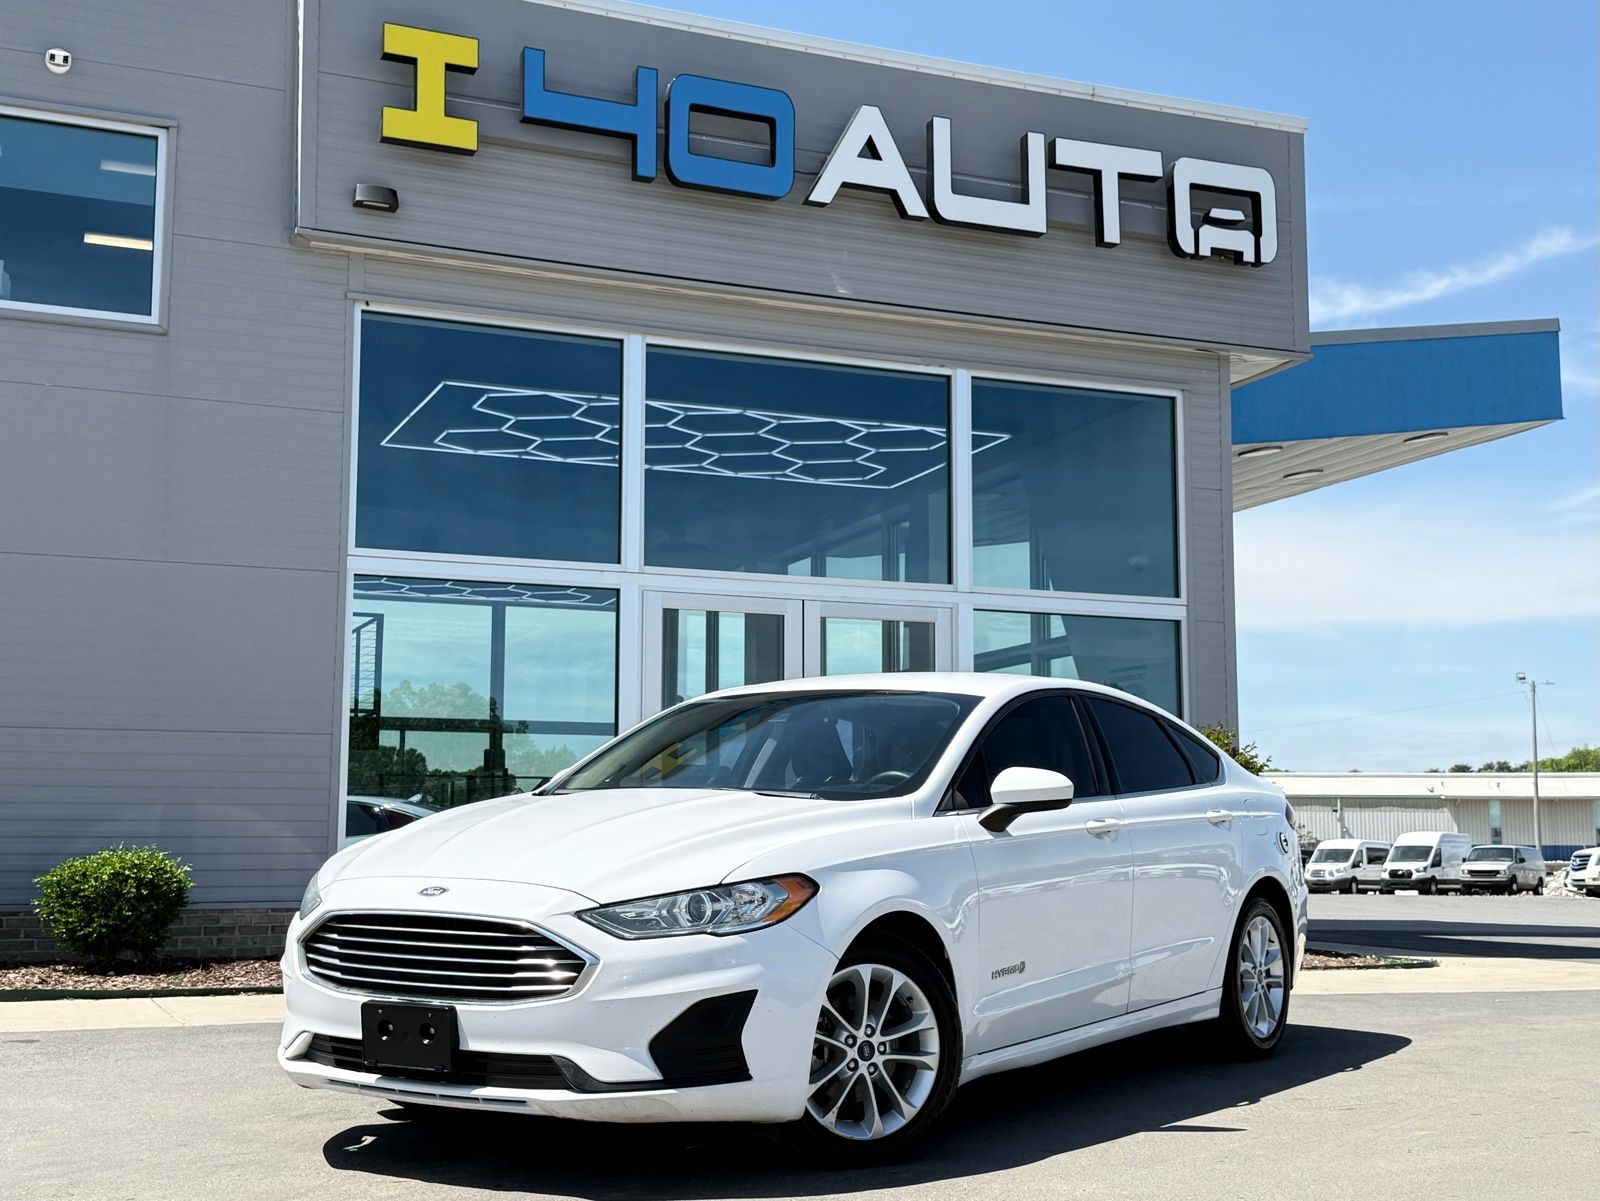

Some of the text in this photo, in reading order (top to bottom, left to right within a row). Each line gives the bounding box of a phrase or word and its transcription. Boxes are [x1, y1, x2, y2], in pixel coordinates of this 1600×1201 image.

[381, 22, 1278, 267] I 40 AUTO
